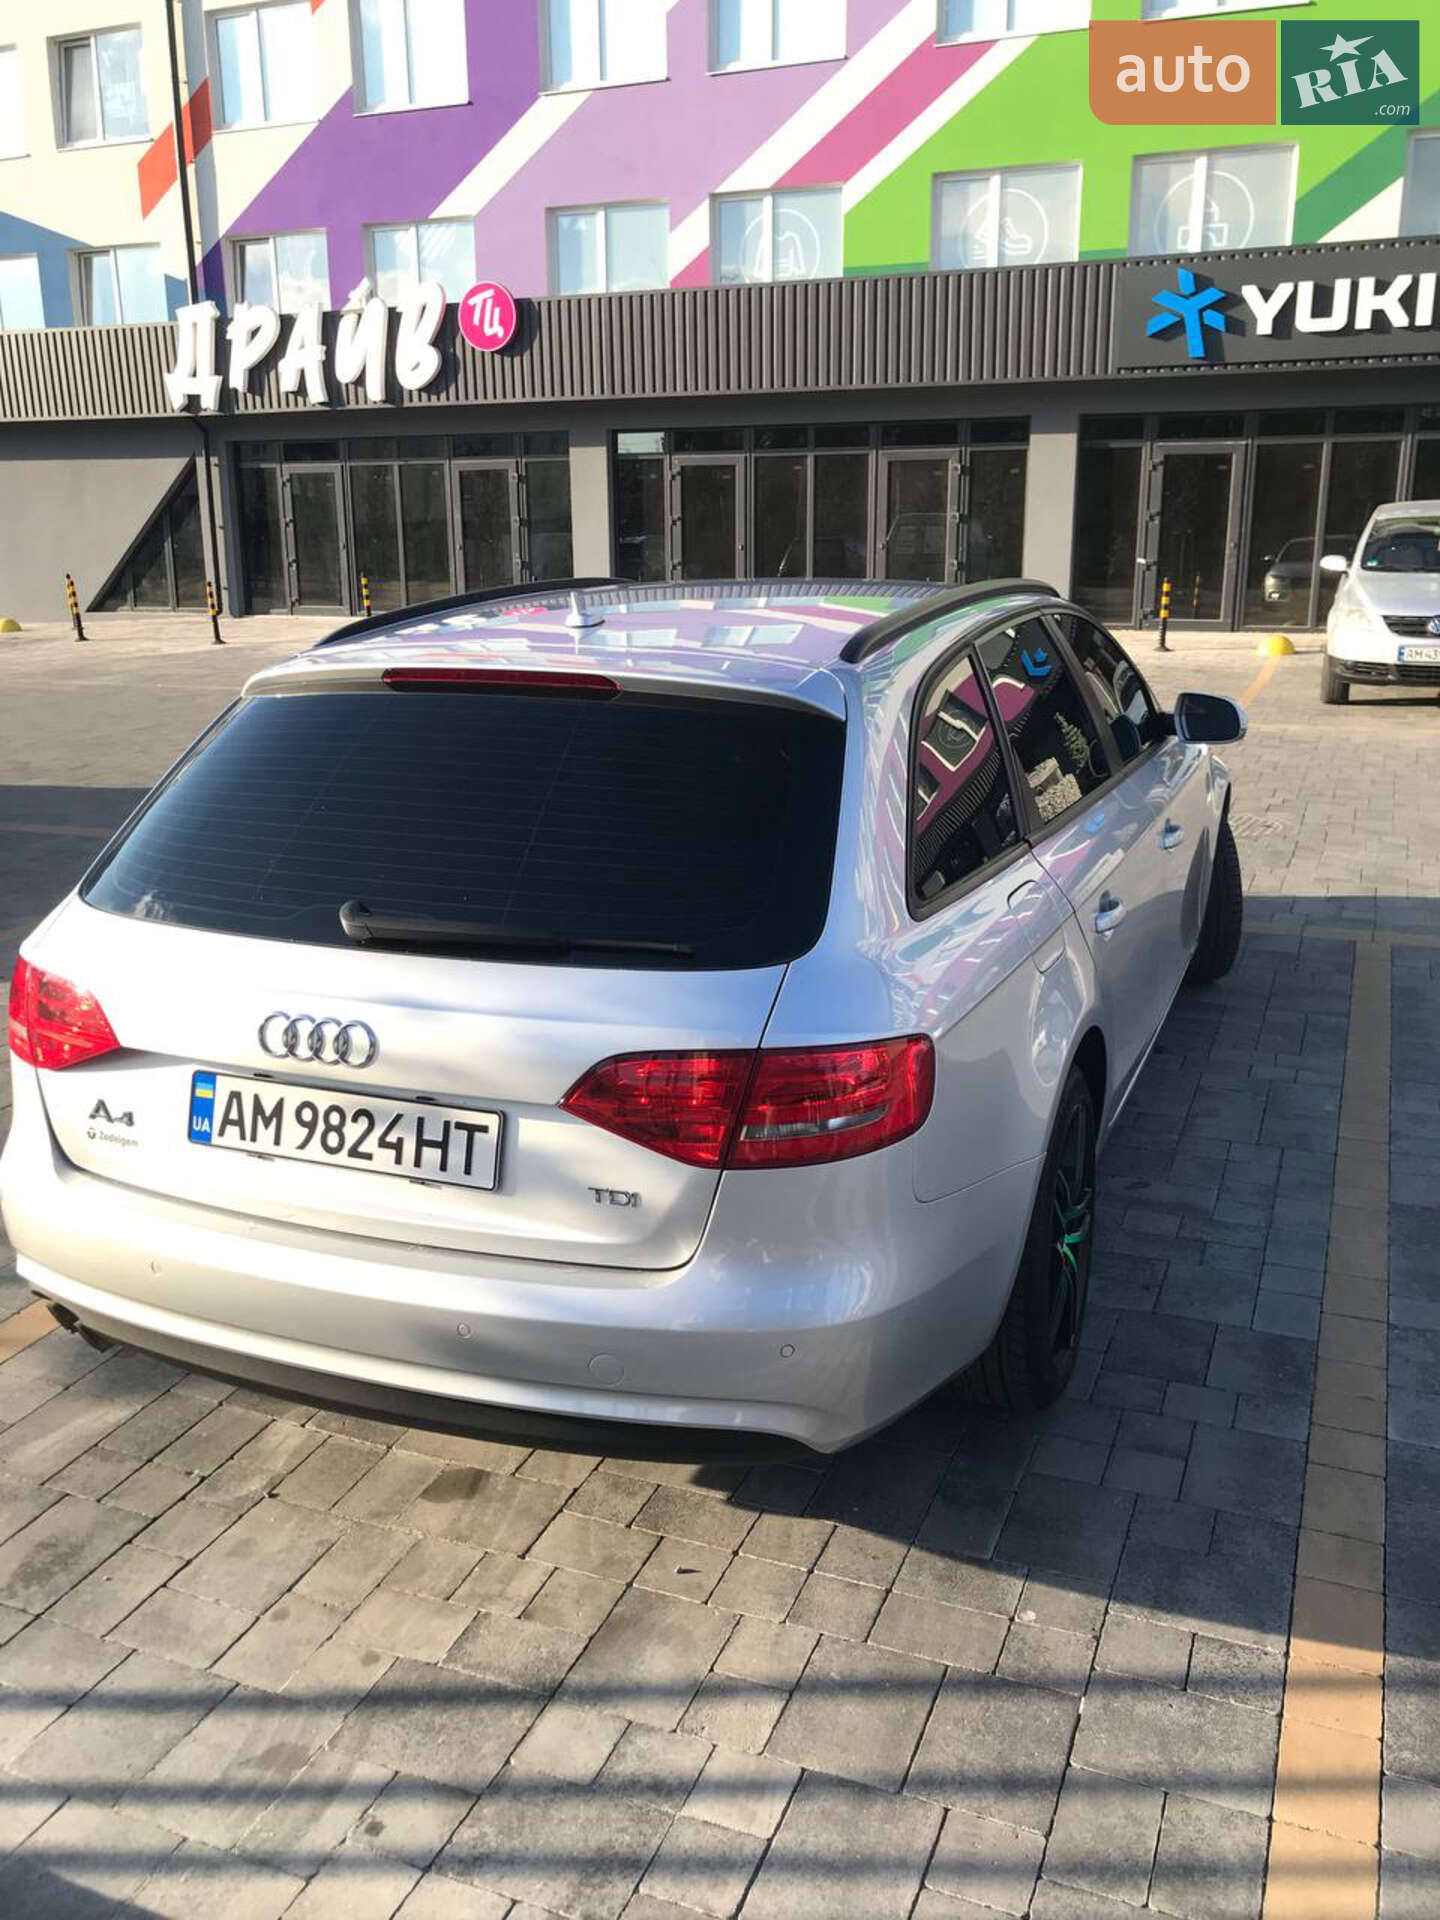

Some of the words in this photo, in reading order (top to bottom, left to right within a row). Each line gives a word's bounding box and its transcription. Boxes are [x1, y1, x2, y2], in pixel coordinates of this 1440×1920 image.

[1241, 272, 1438, 336] YUKI
[162, 276, 447, 414] ДРАЙВ
[88, 1098, 135, 1127] A4
[192, 1116, 211, 1133] UA
[587, 1186, 643, 1208] TDI
